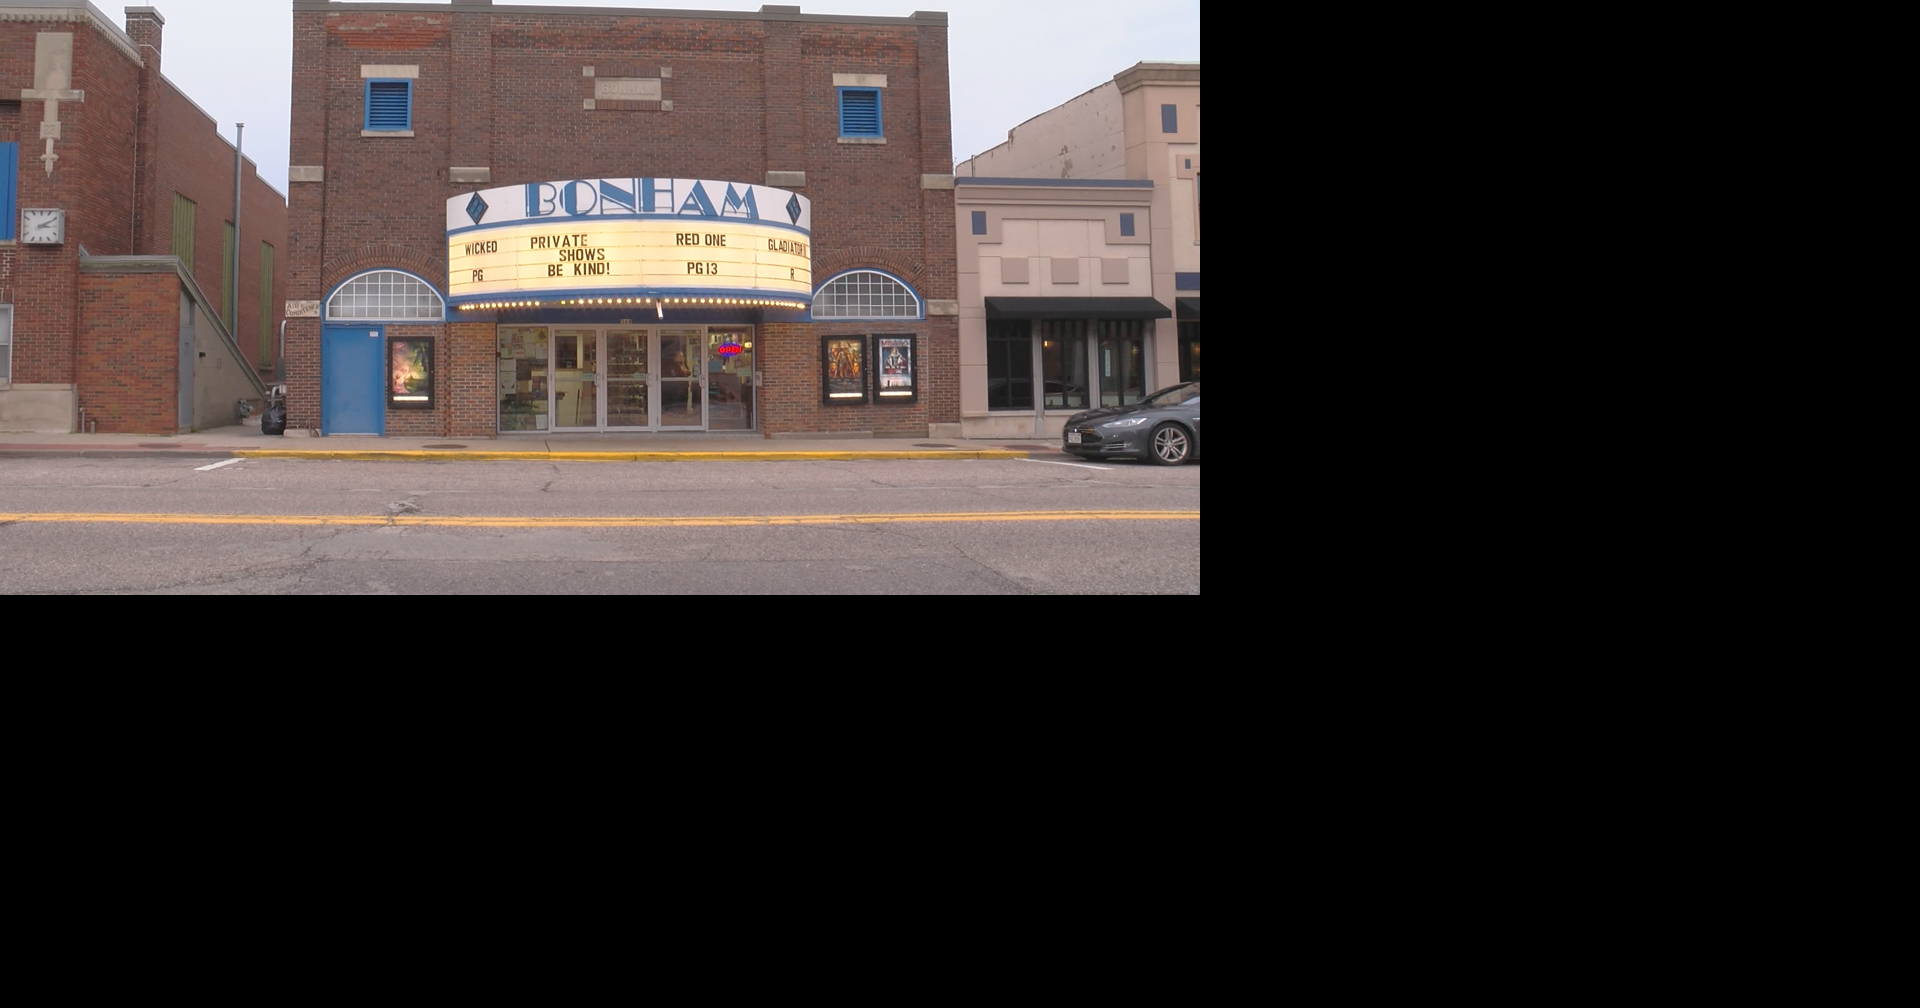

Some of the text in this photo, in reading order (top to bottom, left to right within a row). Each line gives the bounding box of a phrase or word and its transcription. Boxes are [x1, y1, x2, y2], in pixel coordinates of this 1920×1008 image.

[524, 178, 760, 219] BONHAM
[530, 234, 588, 249] PRIVATE
[676, 233, 726, 247] RED ONE
[768, 238, 803, 255] GLADIATOR
[465, 240, 498, 256] WICKED
[559, 248, 605, 262] SHOWS
[472, 269, 483, 282] PG
[547, 262, 610, 277] BE KIND!
[790, 268, 795, 280] R
[718, 345, 742, 354] OPEN
